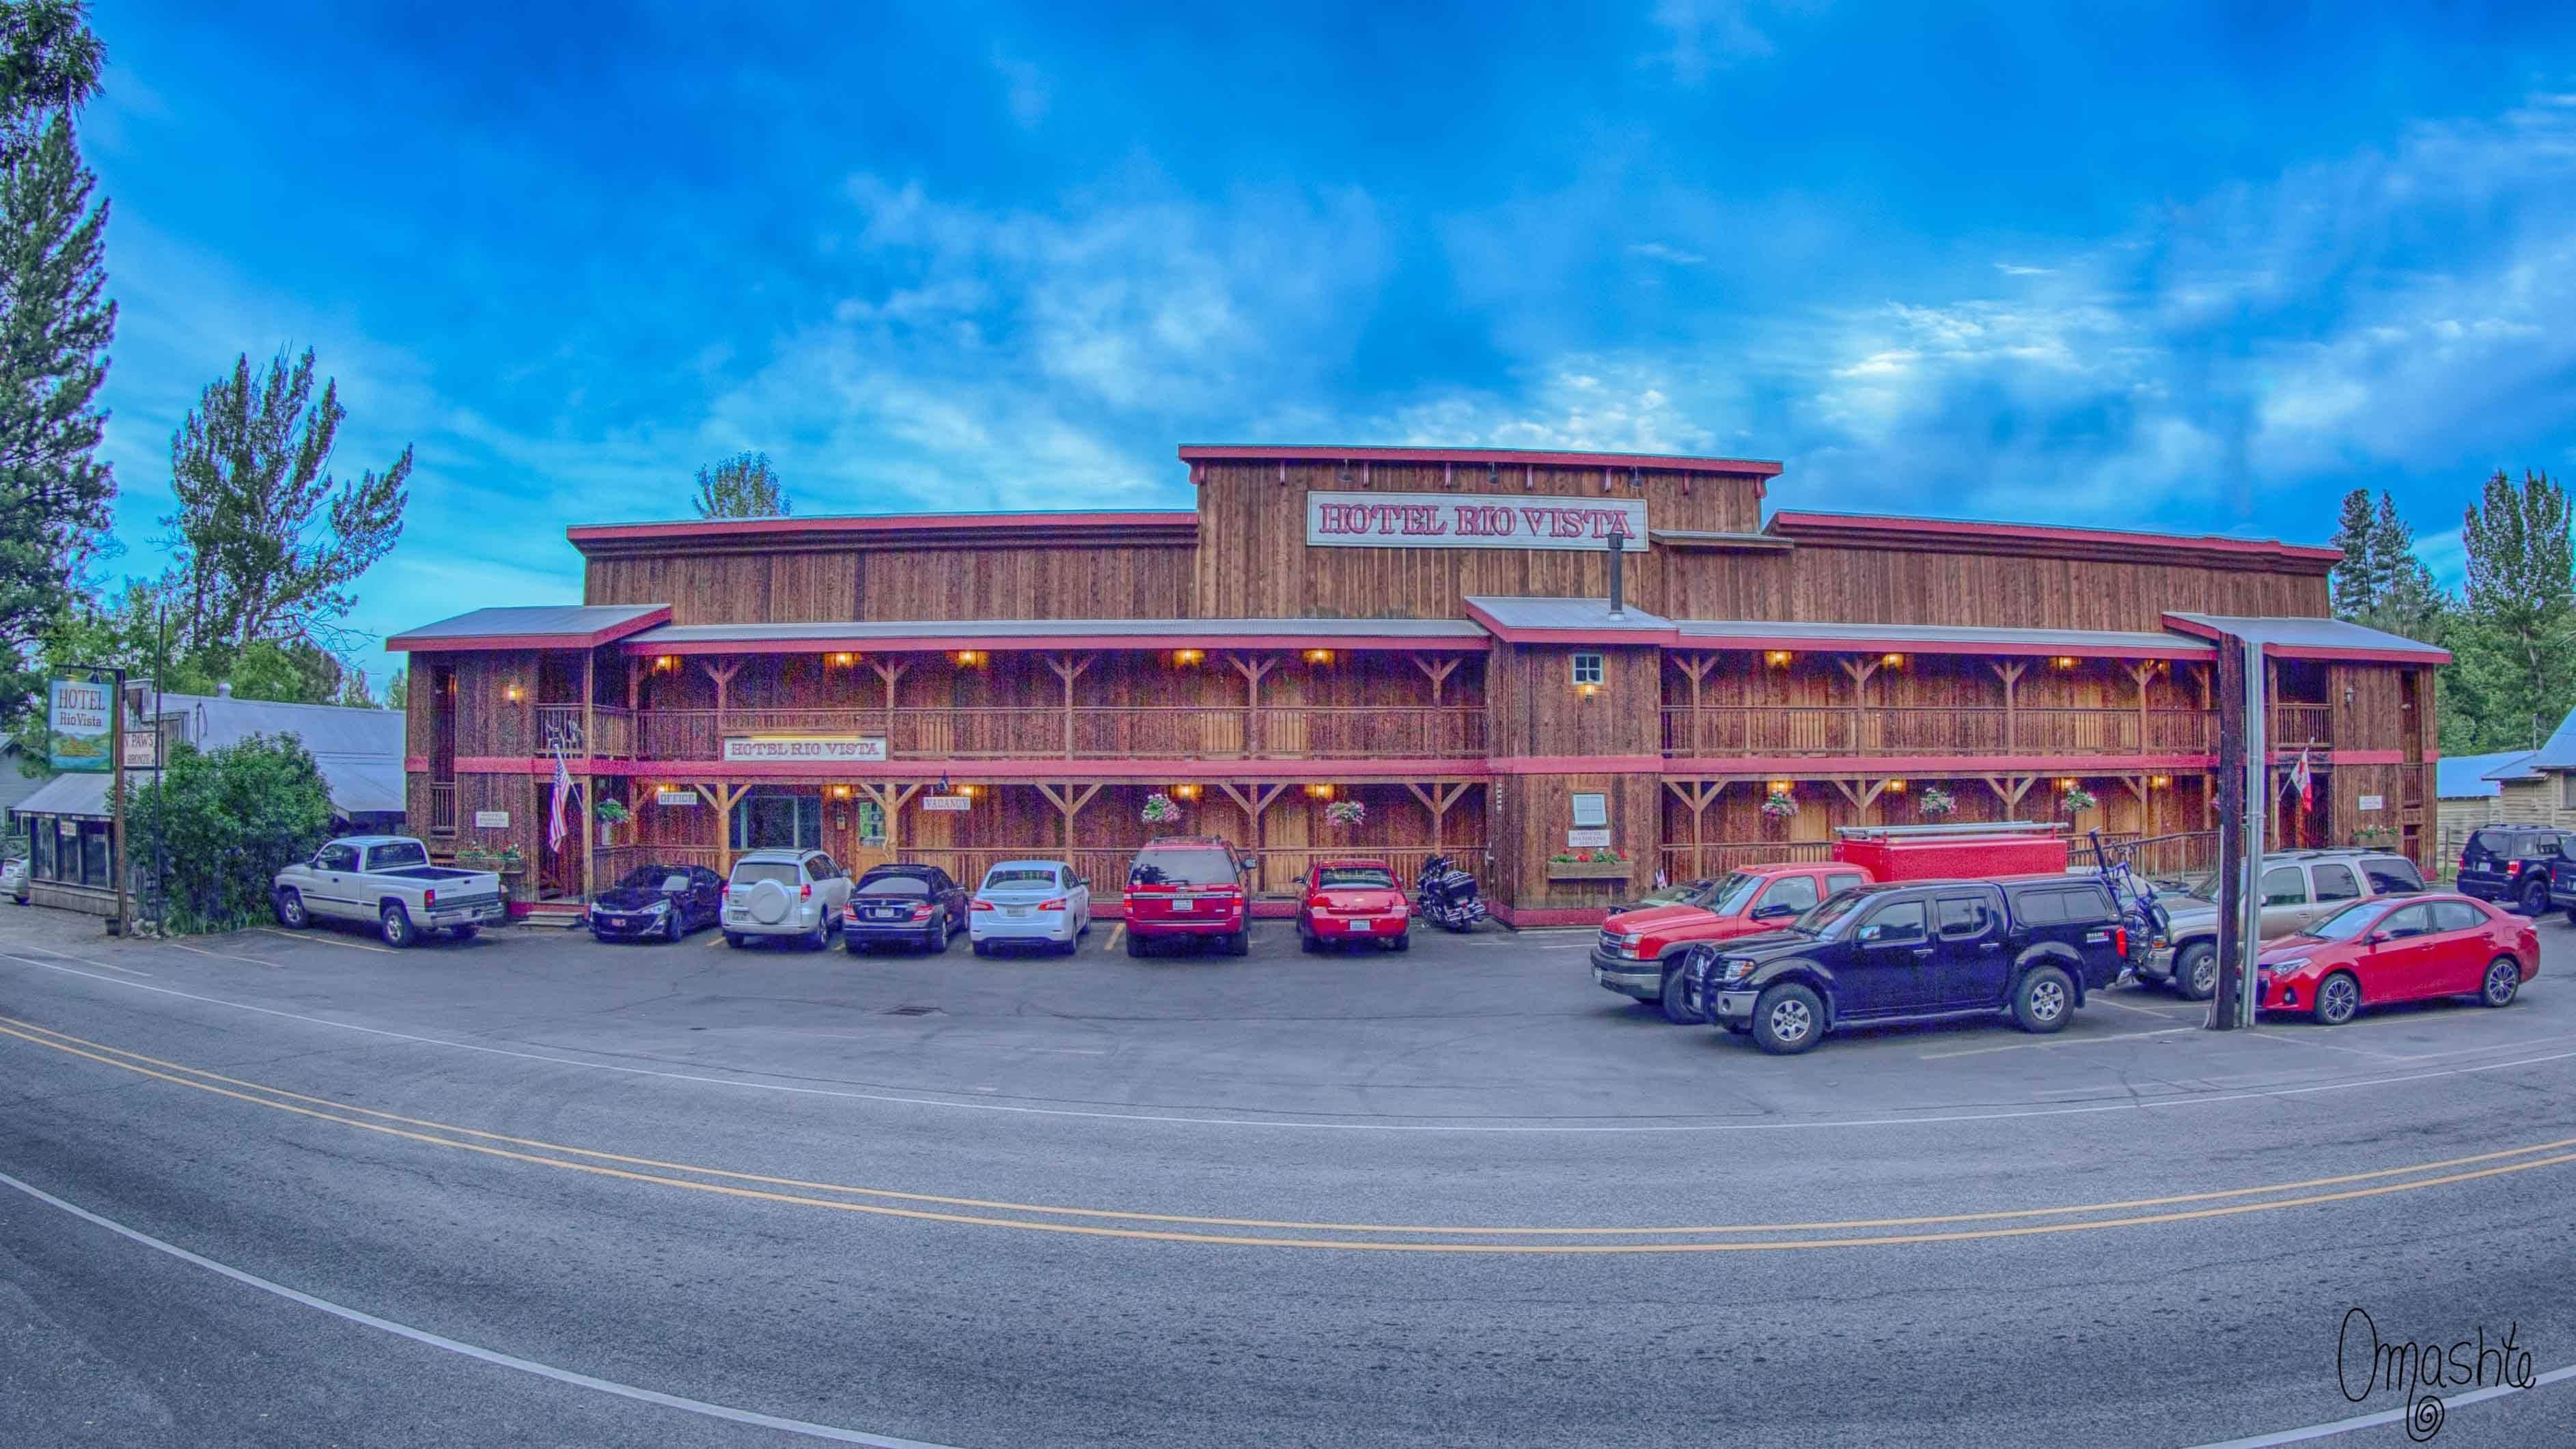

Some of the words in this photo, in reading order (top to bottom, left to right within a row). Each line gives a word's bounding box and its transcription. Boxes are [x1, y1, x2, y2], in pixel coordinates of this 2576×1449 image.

[1319, 503, 1448, 535] HOTEL
[1455, 506, 1516, 536] RIO
[1520, 507, 1635, 540] VISTA
[58, 689, 105, 710] HOTEL
[132, 734, 154, 747] PAWS
[732, 743, 787, 756] HOTEL
[791, 743, 822, 756] RIO
[825, 743, 880, 756] VISTA
[661, 794, 695, 803] OFFICE
[925, 798, 969, 808] VACANCY
